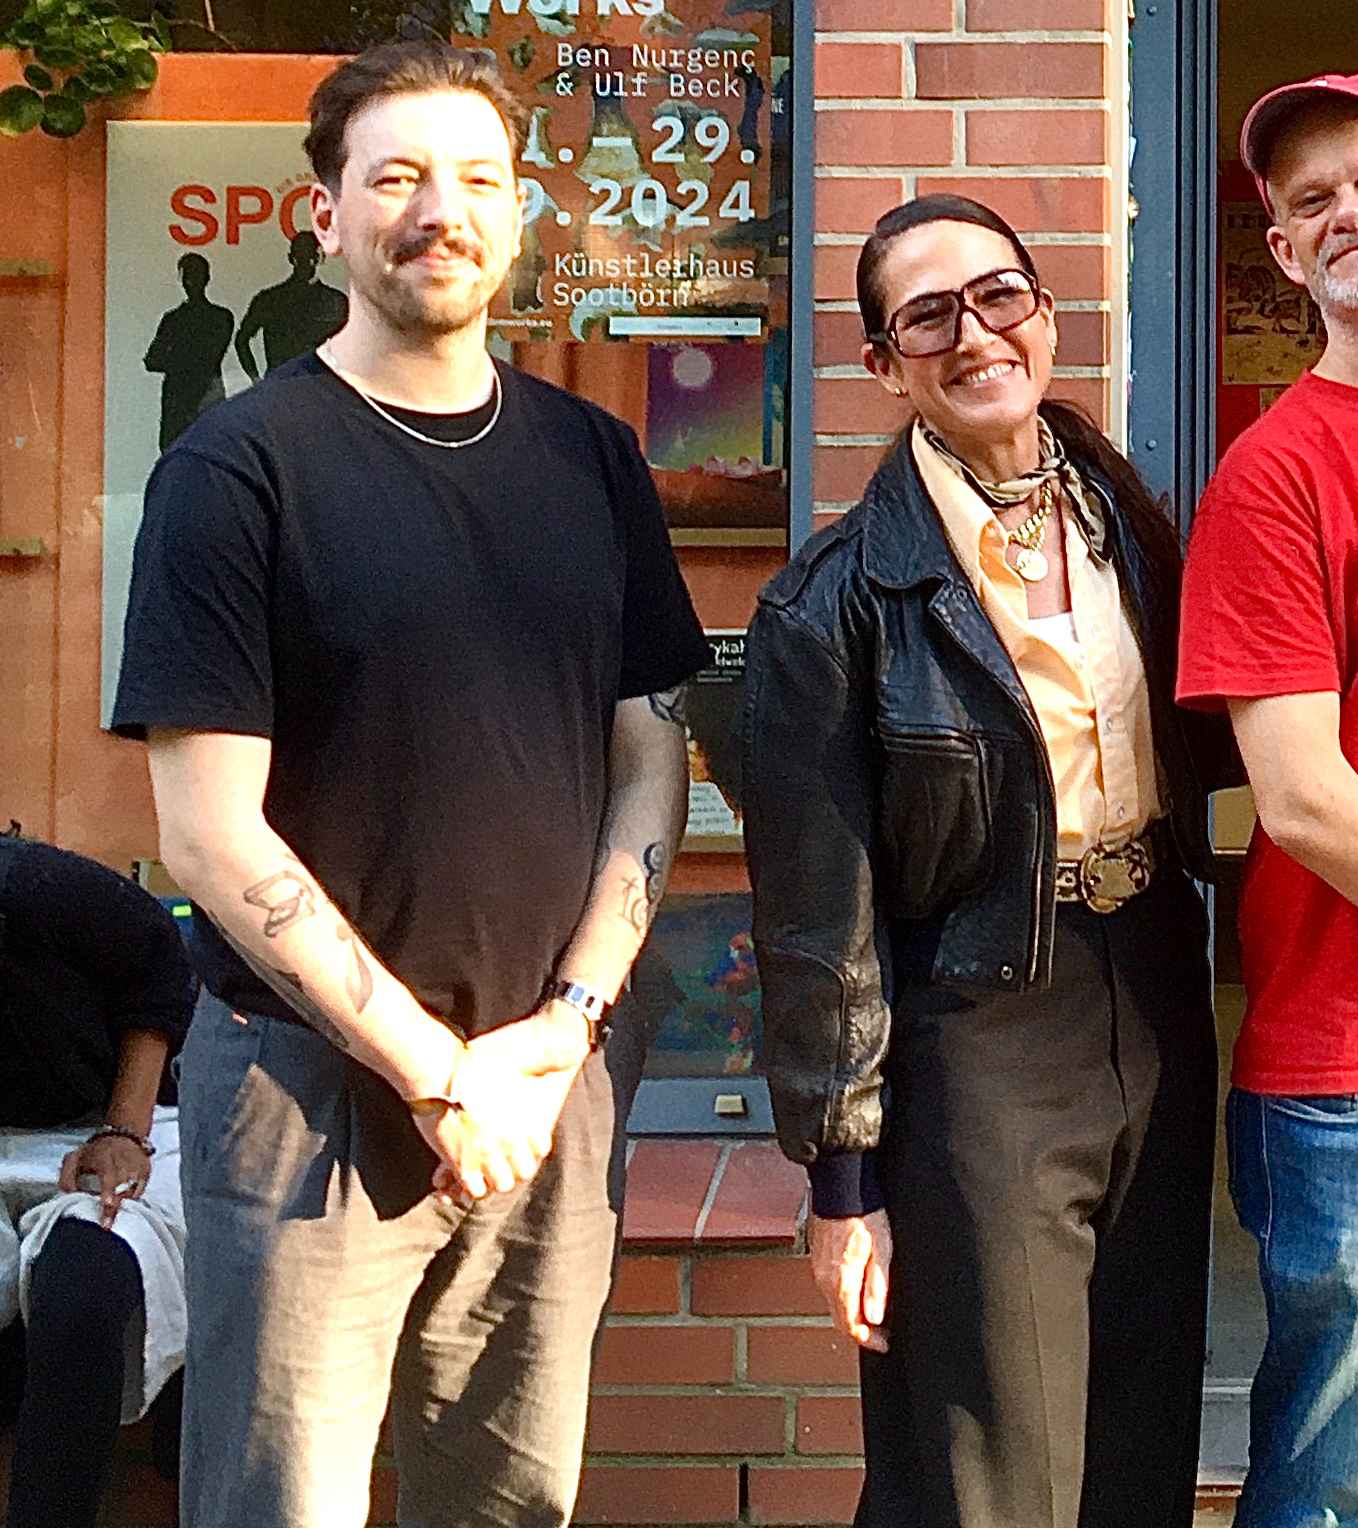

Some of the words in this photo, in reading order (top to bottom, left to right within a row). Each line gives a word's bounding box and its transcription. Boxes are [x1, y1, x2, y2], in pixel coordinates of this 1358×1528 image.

[557, 43, 610, 67] Ben
[632, 43, 755, 74] Nurgenç
[555, 72, 574, 97] &
[595, 72, 648, 97] Ulf
[669, 73, 740, 97] Beck
[651, 115, 755, 164] 29.
[555, 253, 755, 278] Künstlerhaus
[552, 282, 690, 308] Sootbörn
